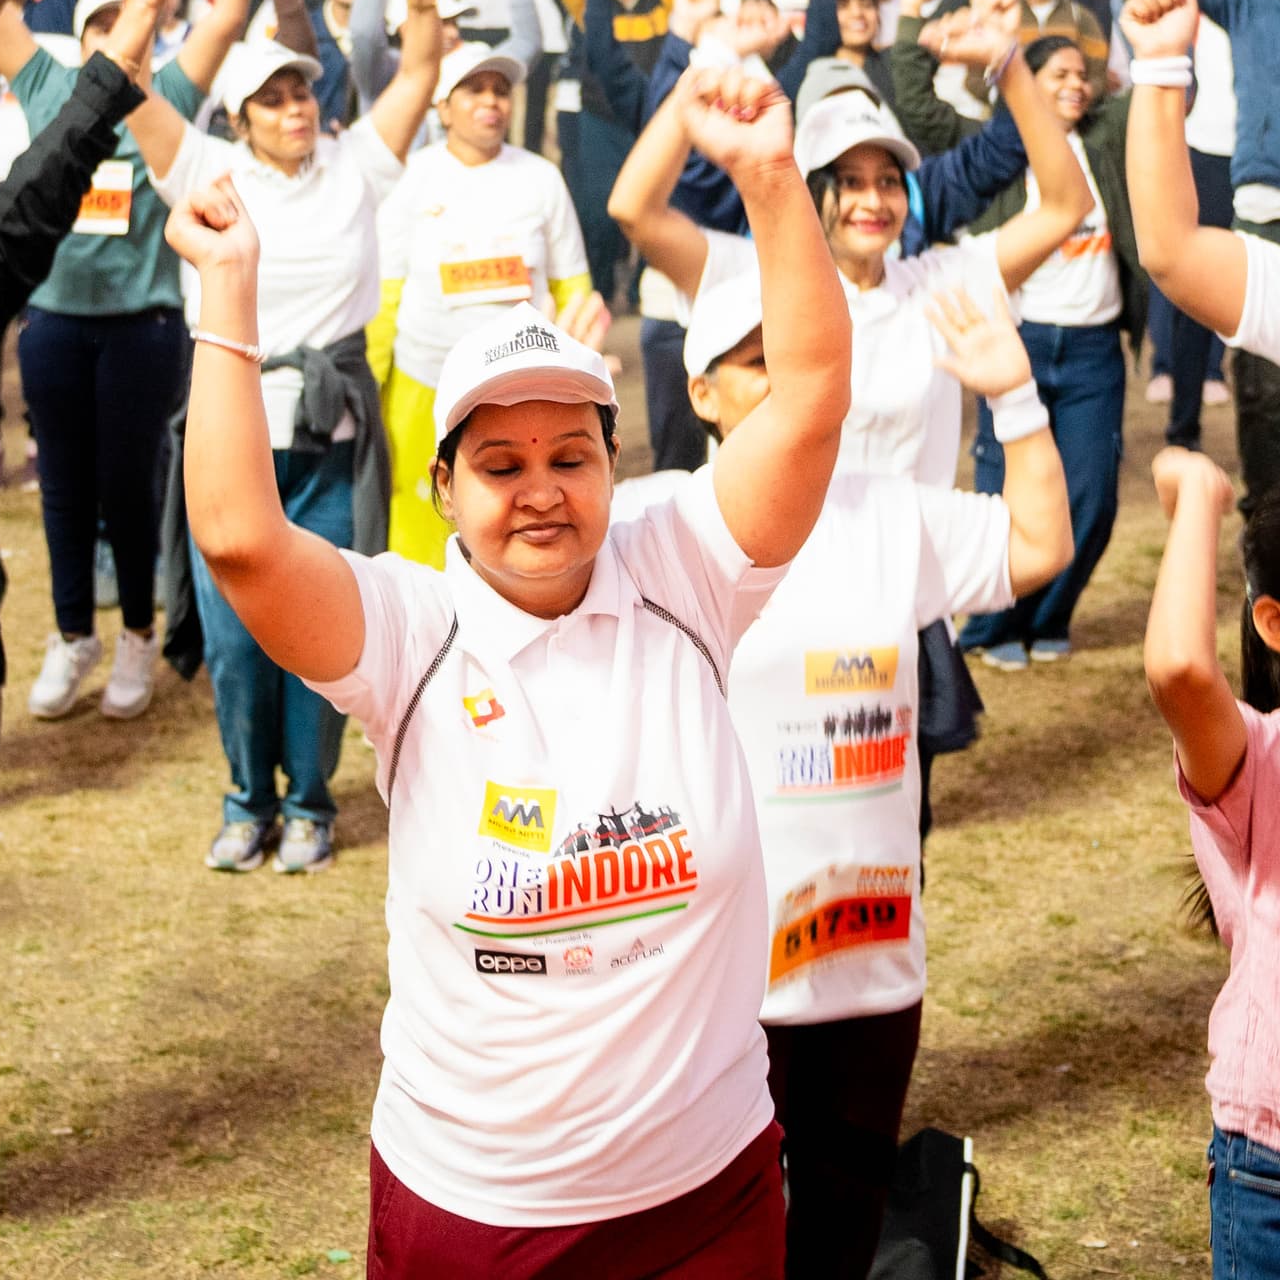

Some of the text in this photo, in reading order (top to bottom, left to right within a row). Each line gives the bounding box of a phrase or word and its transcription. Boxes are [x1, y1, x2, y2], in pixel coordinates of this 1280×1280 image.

[450, 260, 519, 283] 50212
[508, 333, 560, 353] INDORE
[832, 732, 910, 782] INDORE
[472, 827, 698, 916] RUN INDORE
[474, 856, 543, 888] ONE
[479, 954, 543, 974] oppo
[610, 943, 665, 969] accrual
